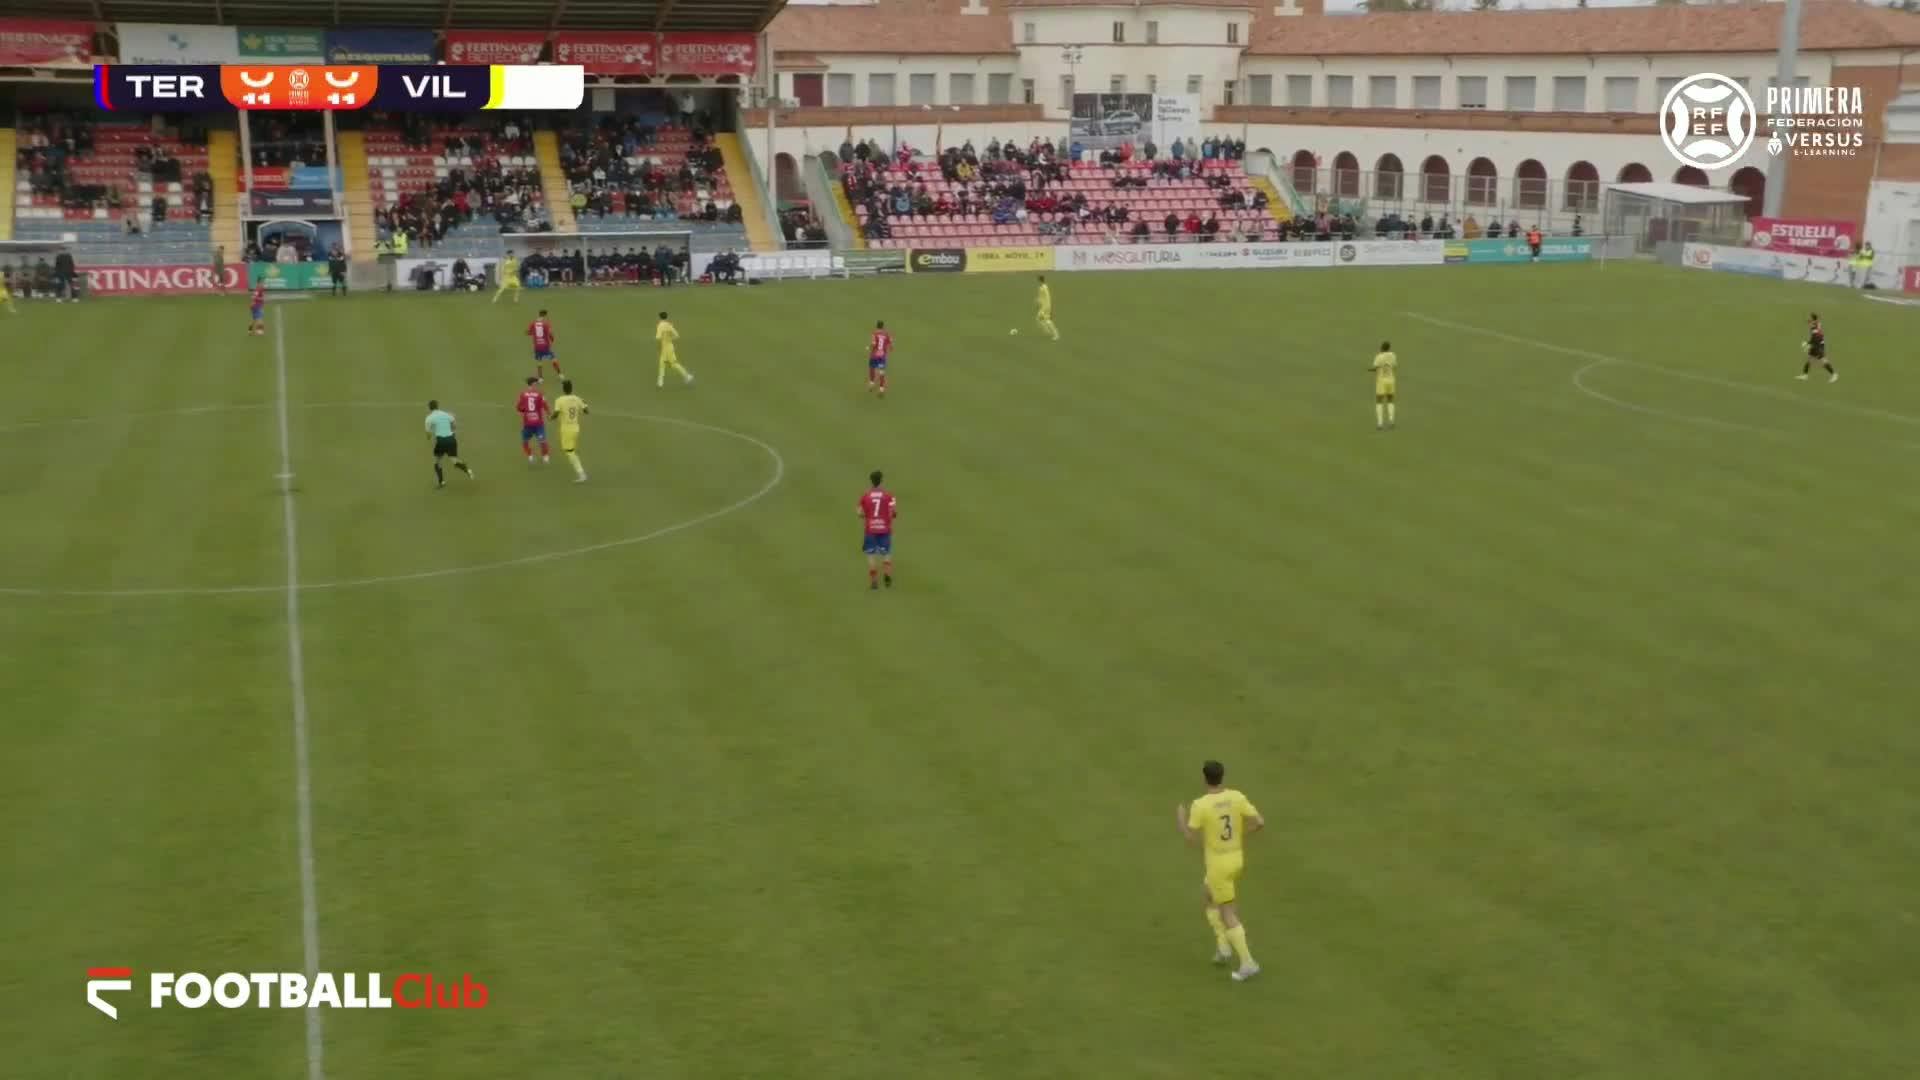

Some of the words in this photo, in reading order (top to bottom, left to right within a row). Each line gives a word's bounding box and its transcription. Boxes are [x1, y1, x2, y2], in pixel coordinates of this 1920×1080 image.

[1771, 223, 1836, 239] ESTRELLA
[527, 397, 537, 412] 6
[871, 498, 881, 517] 7
[1220, 815, 1232, 841] 3
